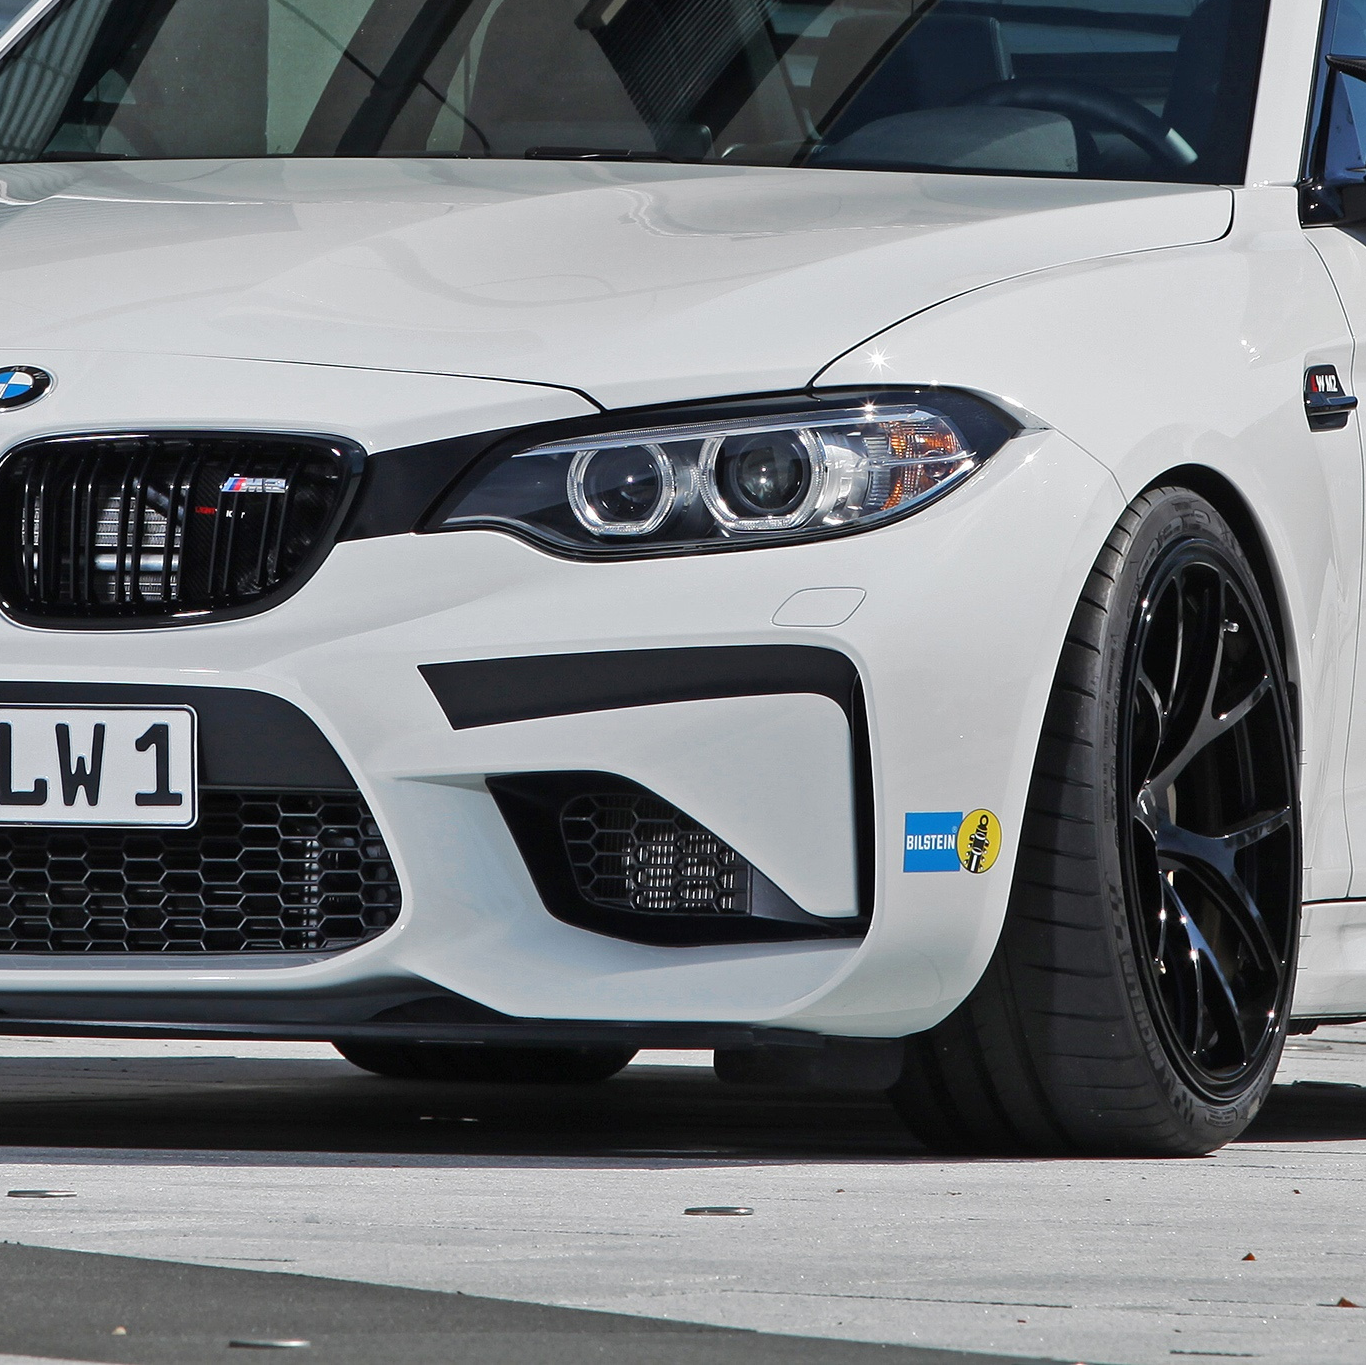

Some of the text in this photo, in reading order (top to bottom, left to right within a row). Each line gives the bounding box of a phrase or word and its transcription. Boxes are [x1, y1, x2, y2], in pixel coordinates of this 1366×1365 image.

[134, 723, 183, 807] 1
[906, 834, 956, 851] BILSTEIN
[1121, 952, 1166, 1072] MICHELIN
